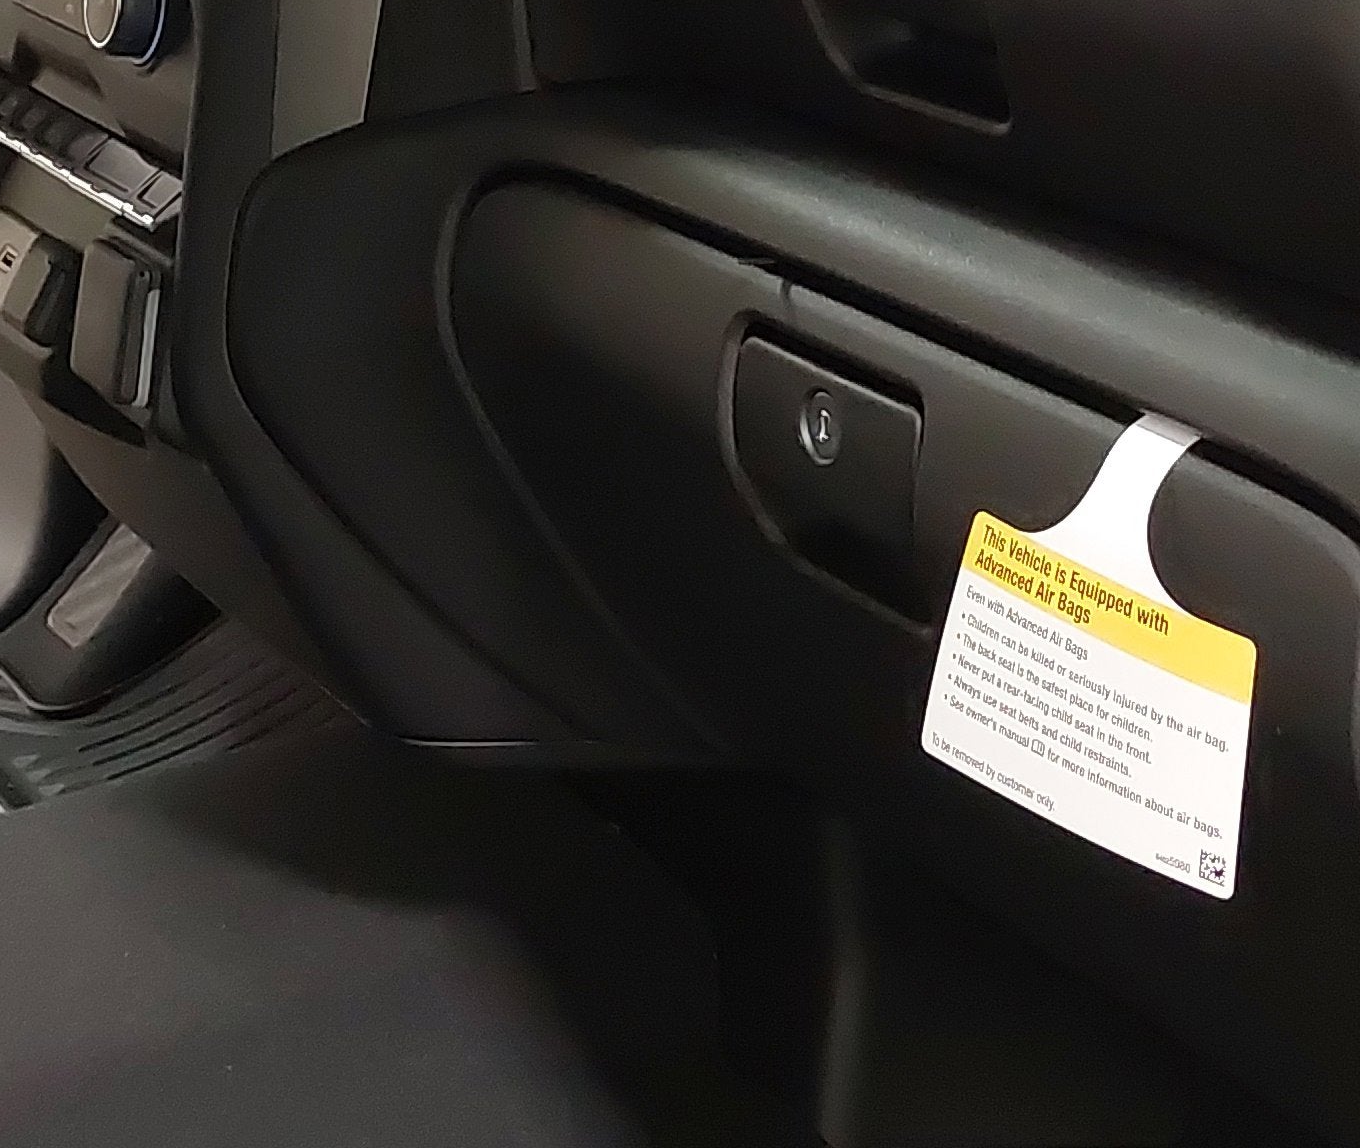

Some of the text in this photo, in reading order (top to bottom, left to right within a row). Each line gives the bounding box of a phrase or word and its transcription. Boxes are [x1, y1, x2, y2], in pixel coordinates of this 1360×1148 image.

[967, 585, 1088, 660] Even with Advanced Air Bags
[975, 548, 1091, 624] Advanced Air Bags
[983, 524, 1169, 636] This Vehicle is Equipped with
[953, 674, 981, 699] Always
[999, 702, 1017, 720] seat
[1041, 724, 1058, 741] and
[1060, 734, 1082, 753] child
[958, 654, 980, 675] Never
[981, 670, 995, 685] put
[1051, 706, 1073, 725] child
[1075, 719, 1094, 737] seat
[1096, 727, 1105, 742] in
[1108, 733, 1123, 750] the
[963, 633, 976, 651] The
[978, 642, 996, 663] back
[998, 656, 1015, 674] seat
[1017, 663, 1024, 677] is
[1026, 669, 1040, 685] the
[1042, 679, 1068, 701] safest
[1069, 693, 1094, 714] place
[1096, 704, 1109, 721] for
[967, 614, 999, 642] Children
[1001, 635, 1016, 650] can
[1018, 641, 1028, 656] be
[1031, 648, 1055, 671] killed
[1057, 665, 1067, 676] or
[1069, 671, 1111, 701] seriously
[1113, 689, 1148, 717] injured
[1151, 707, 1163, 724] by
[1166, 715, 1183, 732] the
[1187, 726, 1202, 740] air
[932, 731, 939, 747] To
[941, 738, 950, 753] be
[985, 764, 995, 780] by
[999, 725, 1030, 748] manual
[1047, 748, 1060, 764] for
[1062, 758, 1085, 777] more
[1087, 768, 1142, 804] information
[1145, 798, 1174, 819] about
[1177, 812, 1191, 825] air
[1194, 817, 1223, 839] bags.
